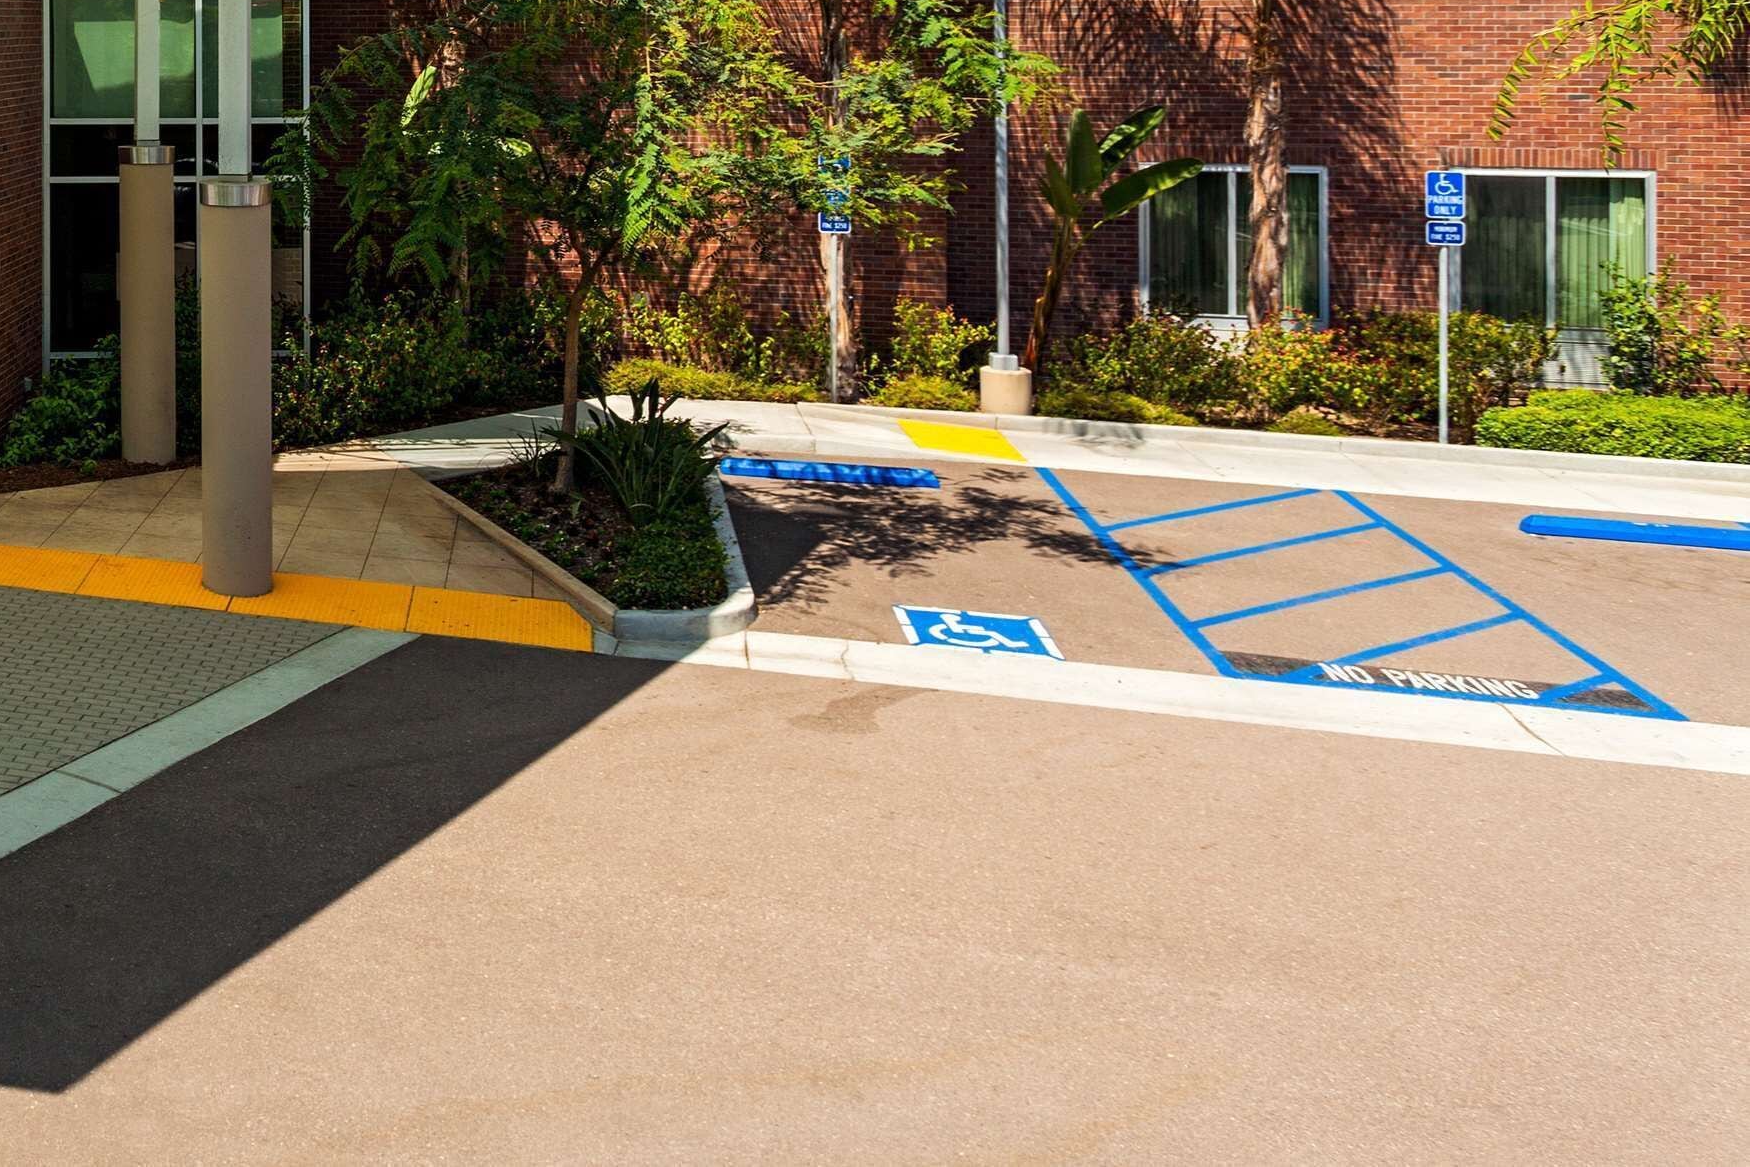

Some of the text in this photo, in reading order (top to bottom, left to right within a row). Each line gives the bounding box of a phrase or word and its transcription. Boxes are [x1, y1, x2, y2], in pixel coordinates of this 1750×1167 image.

[1427, 195, 1463, 205] PARKING
[1433, 205, 1457, 215] ONLY
[1317, 662, 1540, 700] NO PARKING
